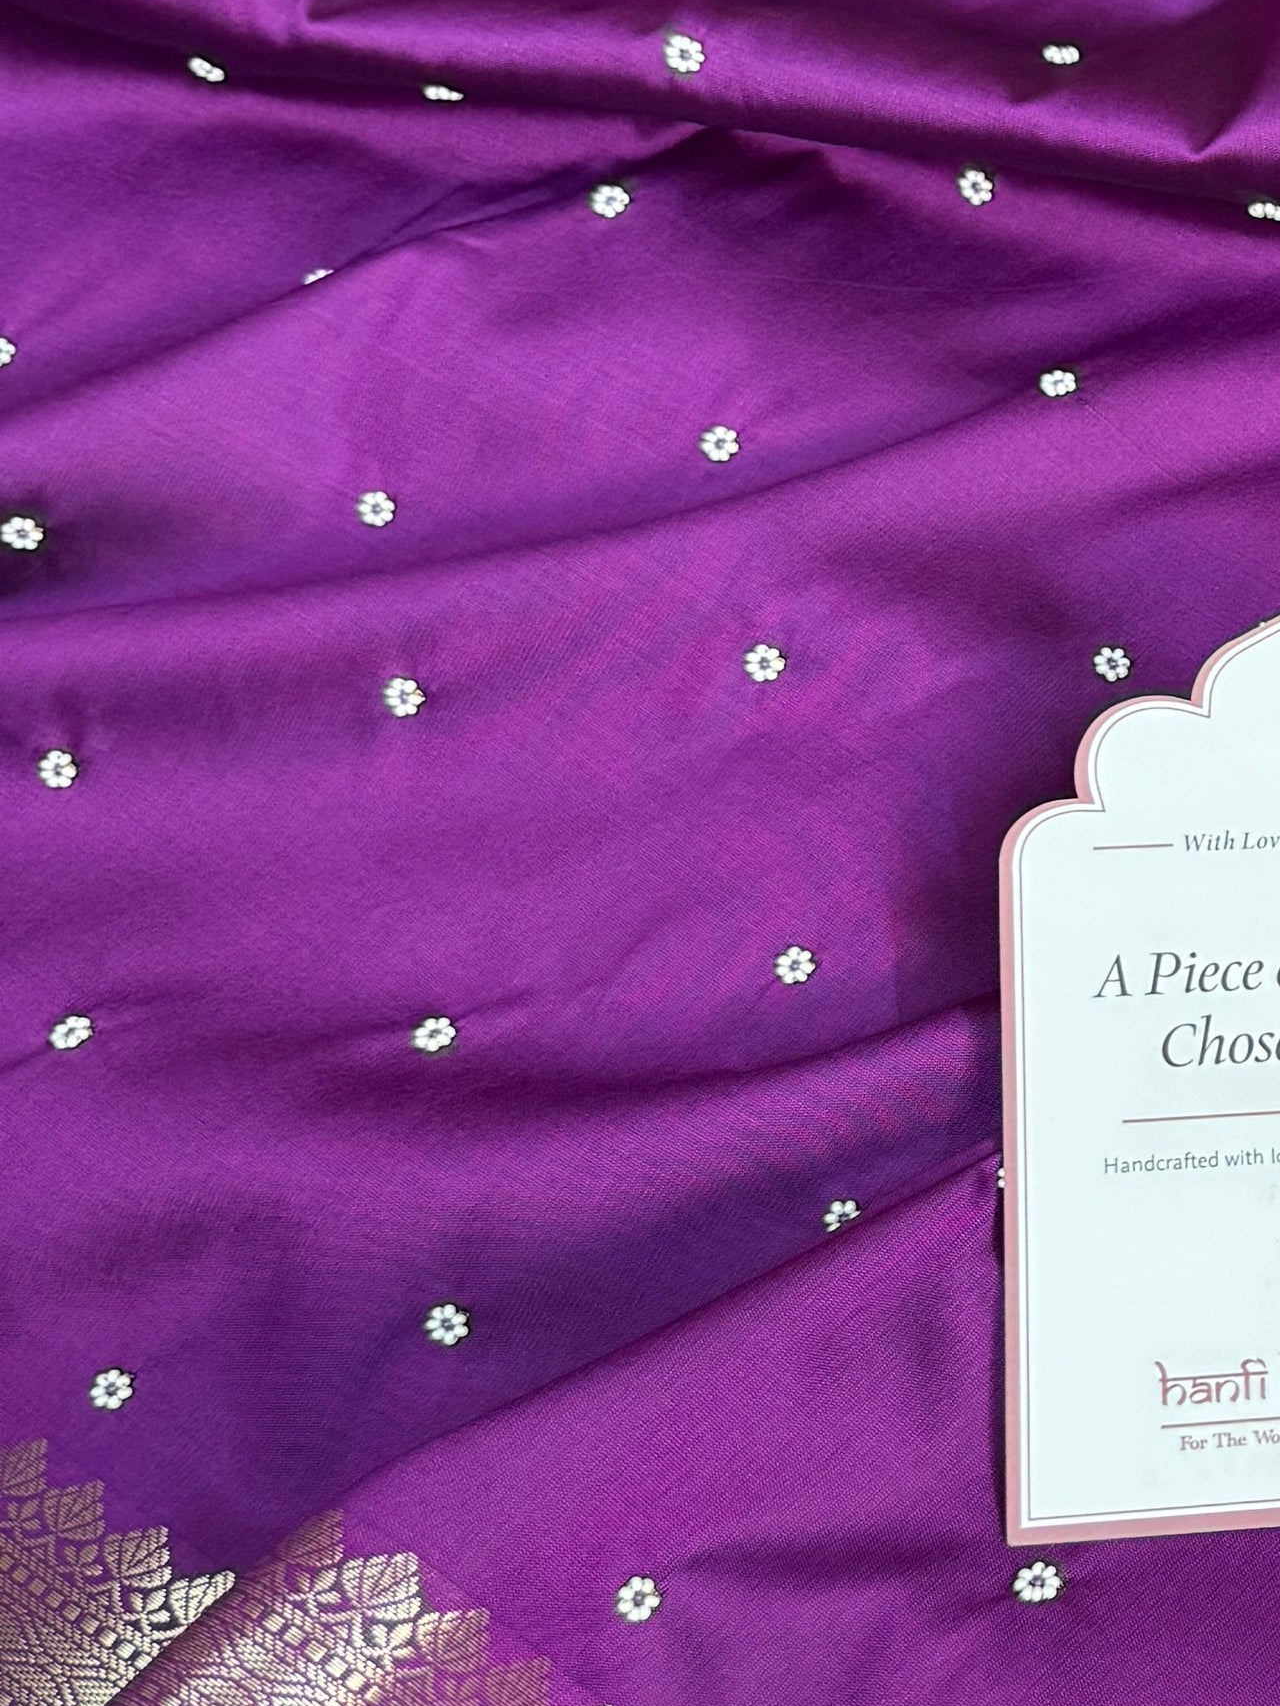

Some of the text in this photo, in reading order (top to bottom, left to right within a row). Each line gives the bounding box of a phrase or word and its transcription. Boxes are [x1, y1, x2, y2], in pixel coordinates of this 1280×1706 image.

[1185, 833, 1234, 851] With
[1093, 954, 1133, 998] A
[1145, 952, 1264, 995] Piece
[1105, 1151, 1218, 1173] Handcrafted
[1225, 1148, 1263, 1166] with
[1180, 1436, 1208, 1451] For
[1213, 1433, 1246, 1448] The
